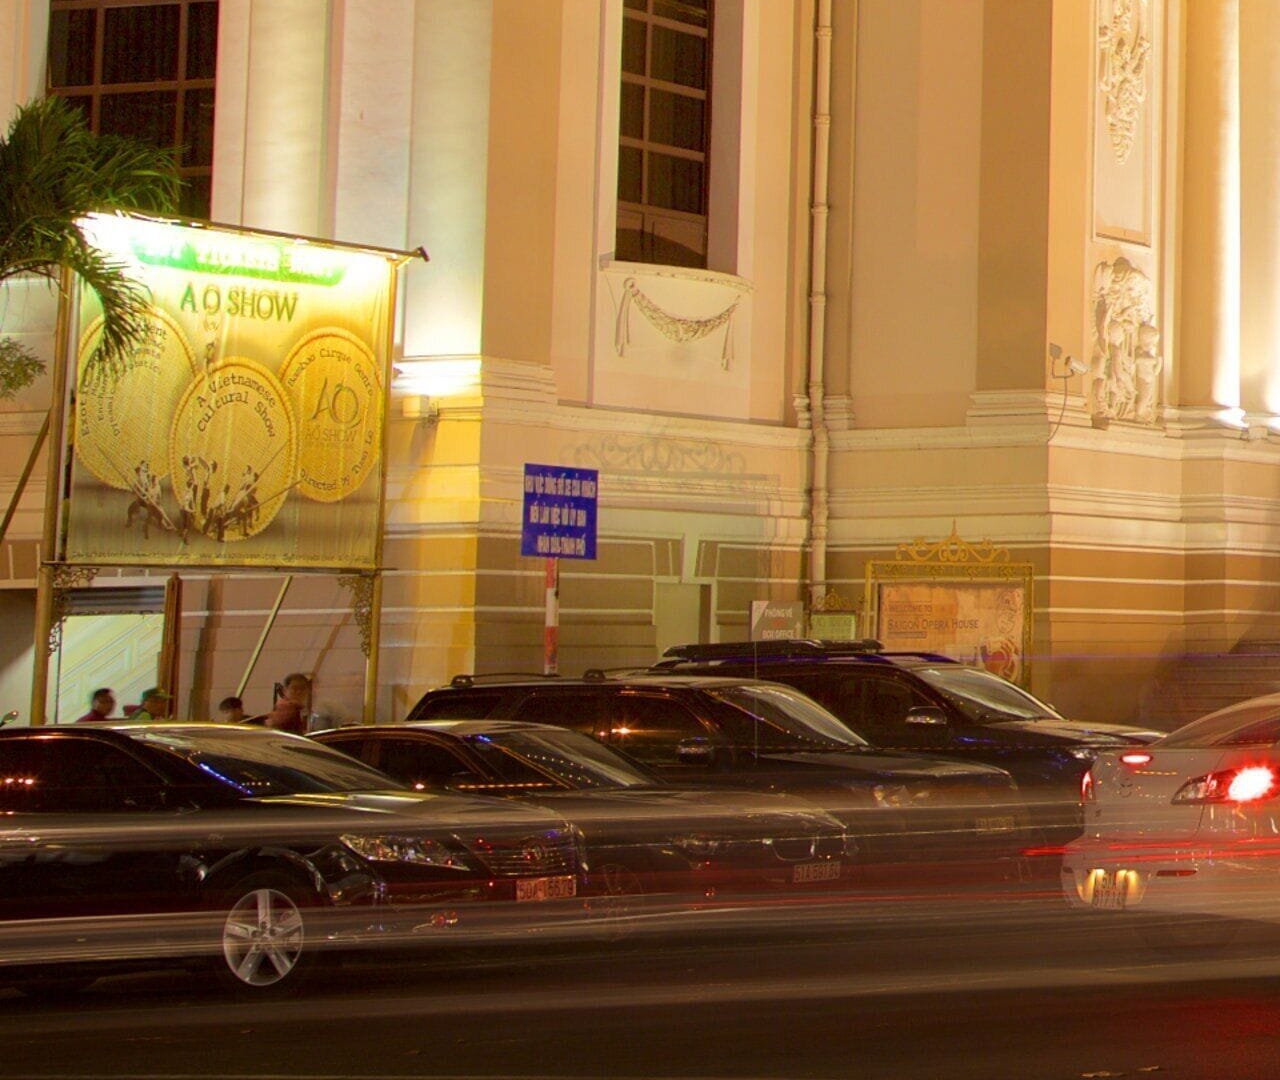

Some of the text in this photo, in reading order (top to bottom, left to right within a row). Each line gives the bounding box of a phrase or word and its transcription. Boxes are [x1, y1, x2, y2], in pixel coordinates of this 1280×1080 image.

[227, 287, 298, 322] SHOW
[208, 373, 276, 408] Vietnamese
[197, 391, 276, 438] Cultural Show
[951, 618, 979, 629] HOUSE
